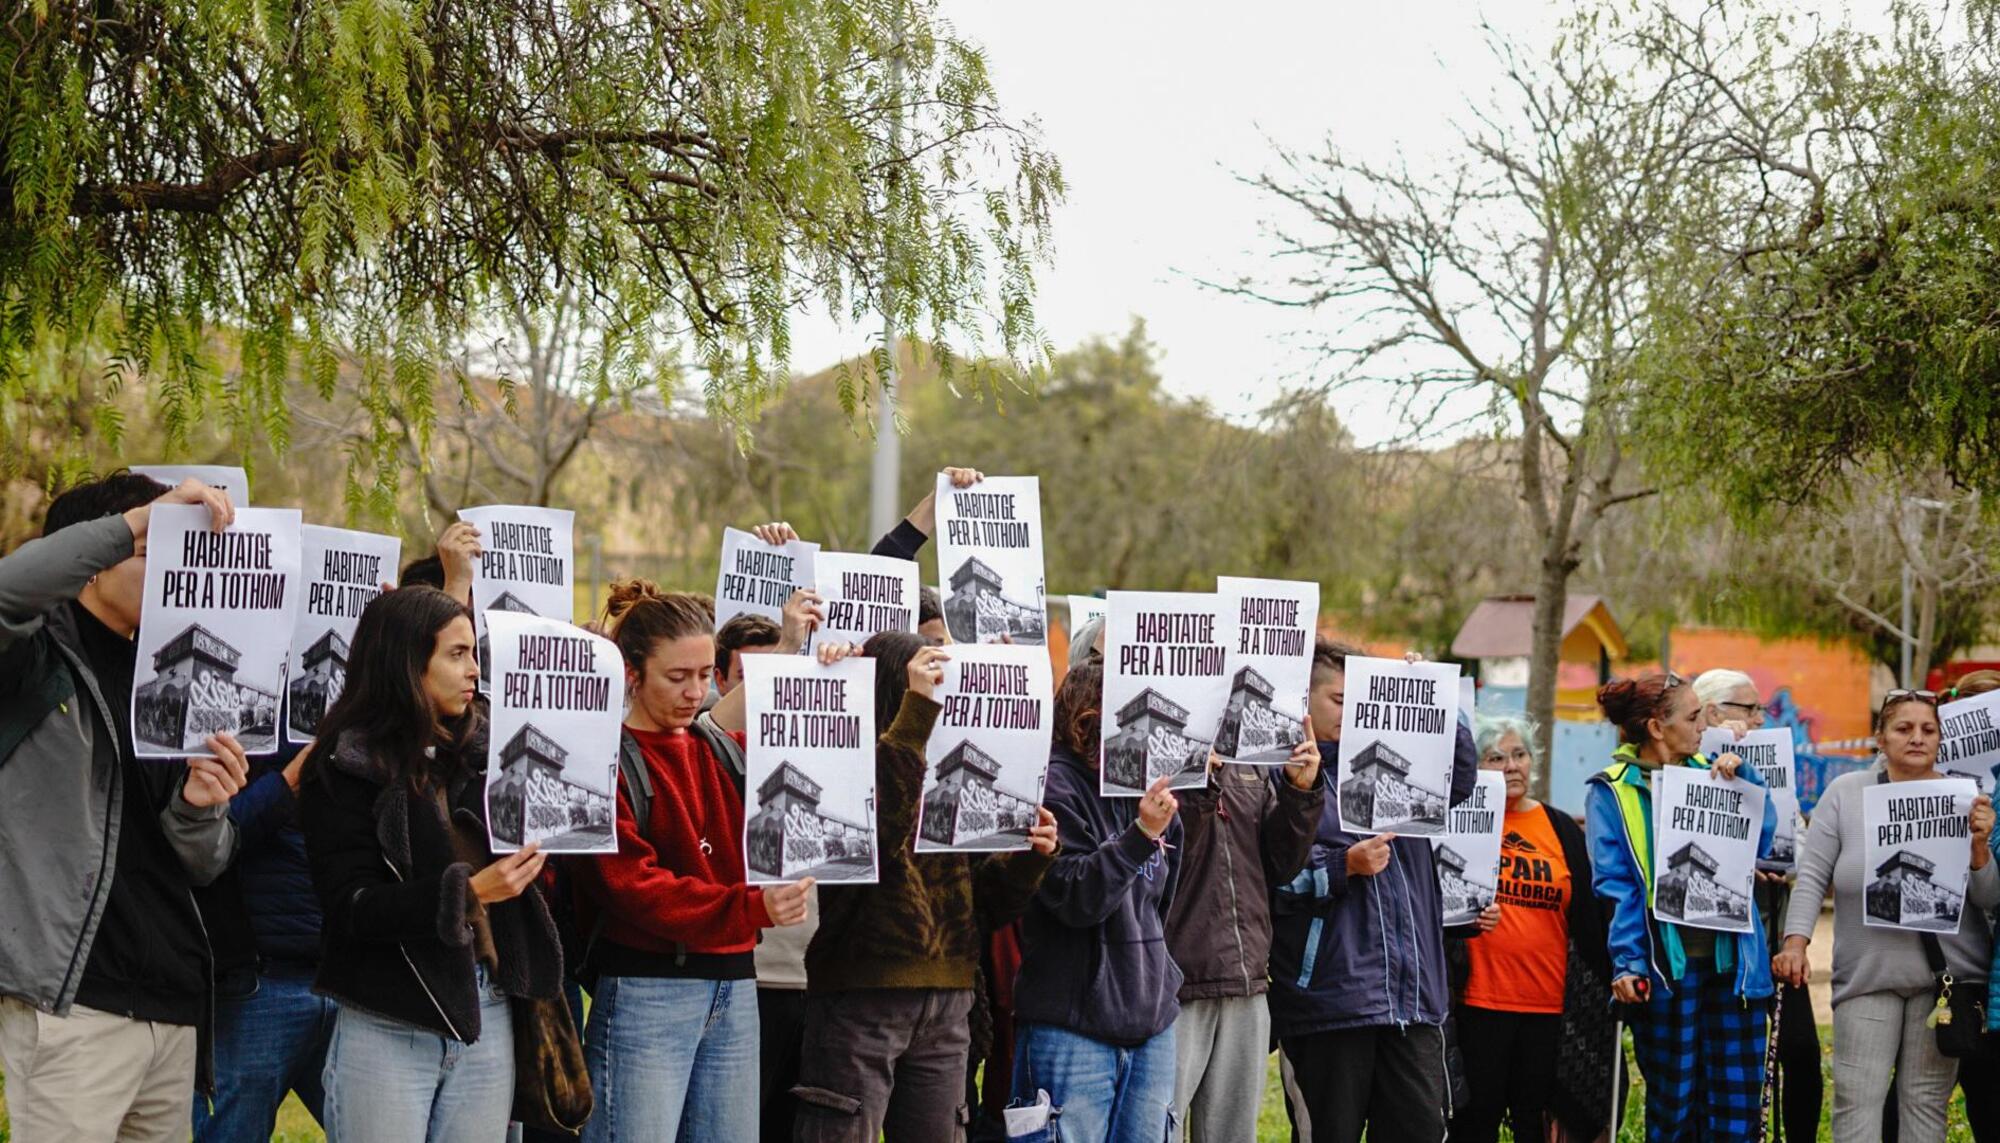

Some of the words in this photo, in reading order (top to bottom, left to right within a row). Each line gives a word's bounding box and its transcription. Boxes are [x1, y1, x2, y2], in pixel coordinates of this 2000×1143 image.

[954, 493, 1016, 520] HABITATGE
[182, 530, 272, 570] HABITATGE
[491, 521, 554, 555] HABITATGE
[948, 520, 971, 546] PER
[973, 520, 981, 546] A
[981, 521, 1029, 548] TOTHOM
[324, 549, 381, 587] HABITATGE
[481, 550, 506, 580] PER
[509, 553, 518, 581] A
[519, 554, 564, 586] TOTHOM
[736, 549, 795, 582] HABITATGE
[162, 570, 198, 608] PER
[201, 571, 213, 609] A
[220, 572, 286, 610] TOTHOM
[308, 582, 334, 616] PER
[335, 585, 344, 617] A
[348, 586, 381, 618] TOT
[723, 574, 746, 602] PER
[746, 577, 755, 603] A
[759, 579, 802, 608] TOTHO
[842, 571, 903, 605] HABITATGE
[827, 601, 853, 631] PER
[854, 603, 864, 632] A
[868, 604, 911, 633] TOTHOM
[1136, 612, 1215, 644] HABITATGE
[1240, 597, 1300, 627] HABITATGE
[518, 634, 597, 673] HABITATGE
[1251, 628, 1259, 655] A
[1263, 628, 1306, 657] TOTHOM
[1120, 645, 1149, 675] PER
[1153, 646, 1164, 676] A
[1168, 646, 1226, 676] TOTHOM
[504, 672, 529, 709] PER
[532, 674, 542, 709] A
[546, 674, 610, 712] TOTHOM
[773, 676, 847, 712] HABITATGE
[959, 662, 1029, 696] HABITATGE
[1369, 675, 1436, 706] HABITATGE
[942, 695, 970, 727] PER
[971, 697, 982, 728] A
[986, 697, 1041, 730] TOTHOM
[1355, 702, 1380, 729] PER
[1382, 705, 1391, 731] A
[1395, 705, 1446, 734] TOTHOM
[1941, 708, 1994, 739] ABITATGE
[760, 713, 786, 747] PER
[789, 714, 799, 747] A
[802, 714, 860, 749] TOTHOM
[1936, 743, 1949, 764] ER
[1951, 740, 1960, 760] A
[1760, 767, 1787, 789] HOM
[1685, 784, 1743, 814] HABITATGE
[1888, 795, 1956, 822] HABITATGE
[1455, 811, 1494, 834] TOTHOM
[1672, 806, 1696, 832] PER
[1696, 812, 1705, 836] A
[1708, 812, 1751, 841] TOTHOM
[1878, 824, 1901, 847] PER
[1904, 823, 1912, 842] A
[1917, 816, 1968, 840] TOTHOM
[1499, 856, 1552, 882] PAH
[1497, 879, 1563, 903] ALLORCA
